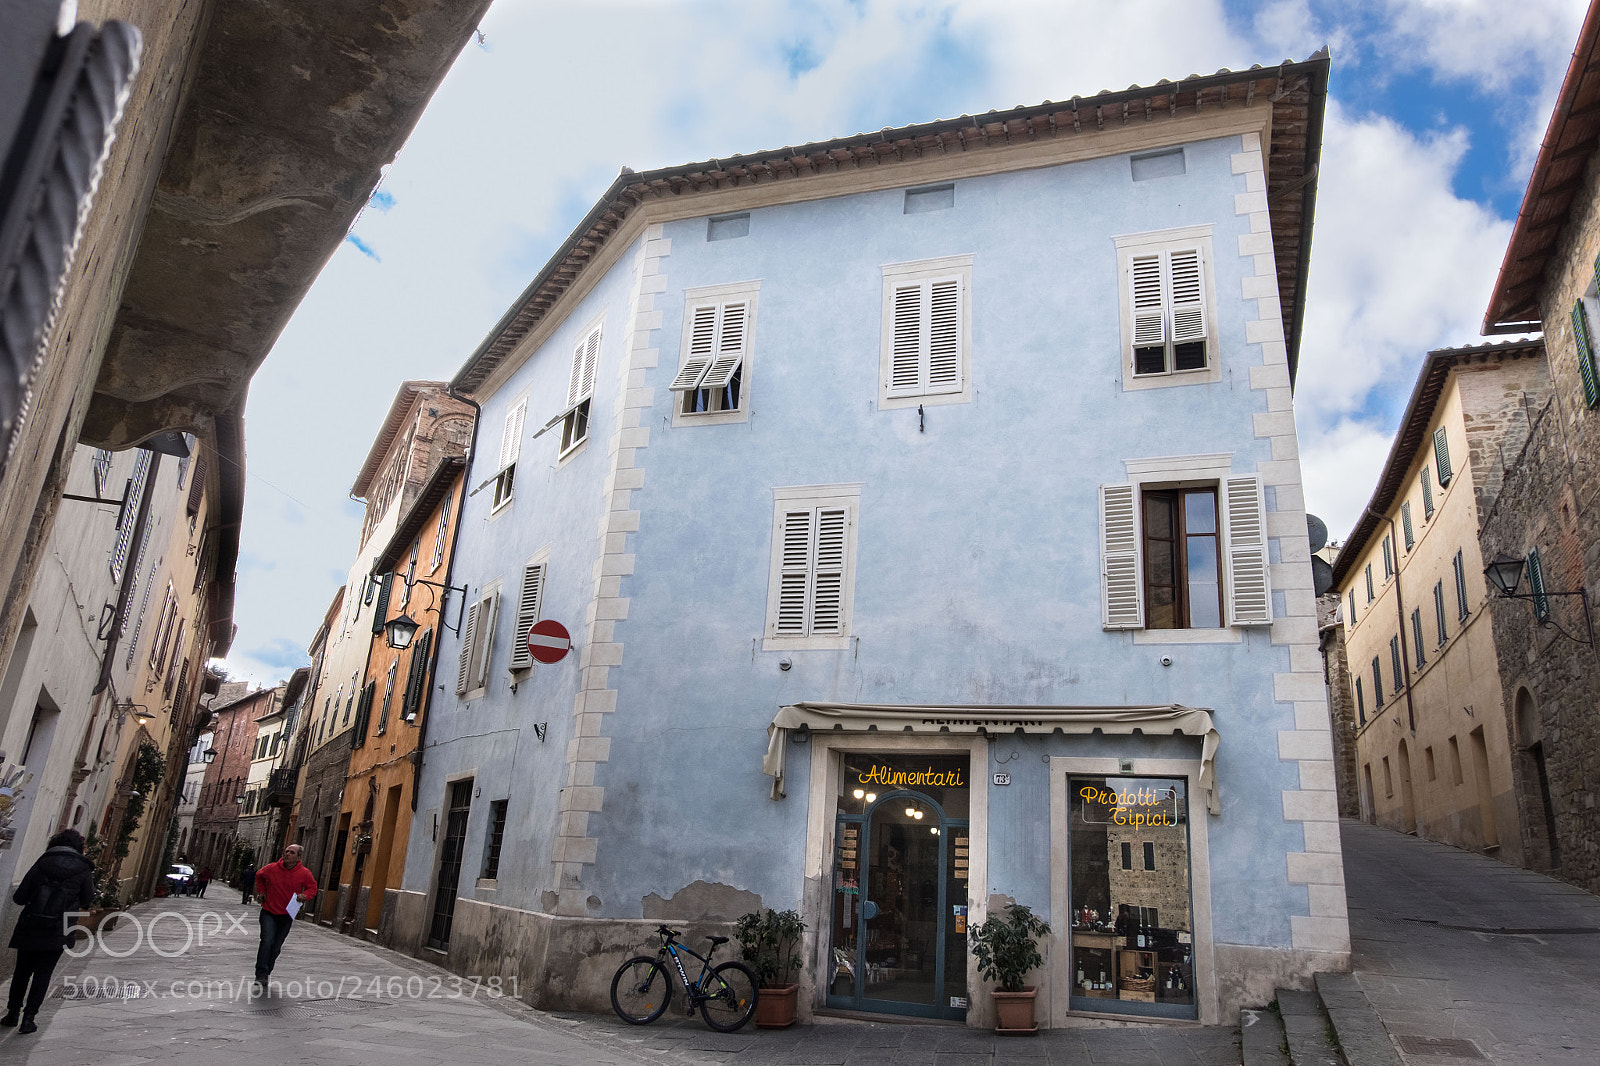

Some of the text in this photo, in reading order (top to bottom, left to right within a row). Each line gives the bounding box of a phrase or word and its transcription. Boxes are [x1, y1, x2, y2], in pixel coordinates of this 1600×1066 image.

[858, 764, 964, 786] Alimentari
[1079, 786, 1160, 806] Prodotti
[1108, 806, 1170, 831] Tipici
